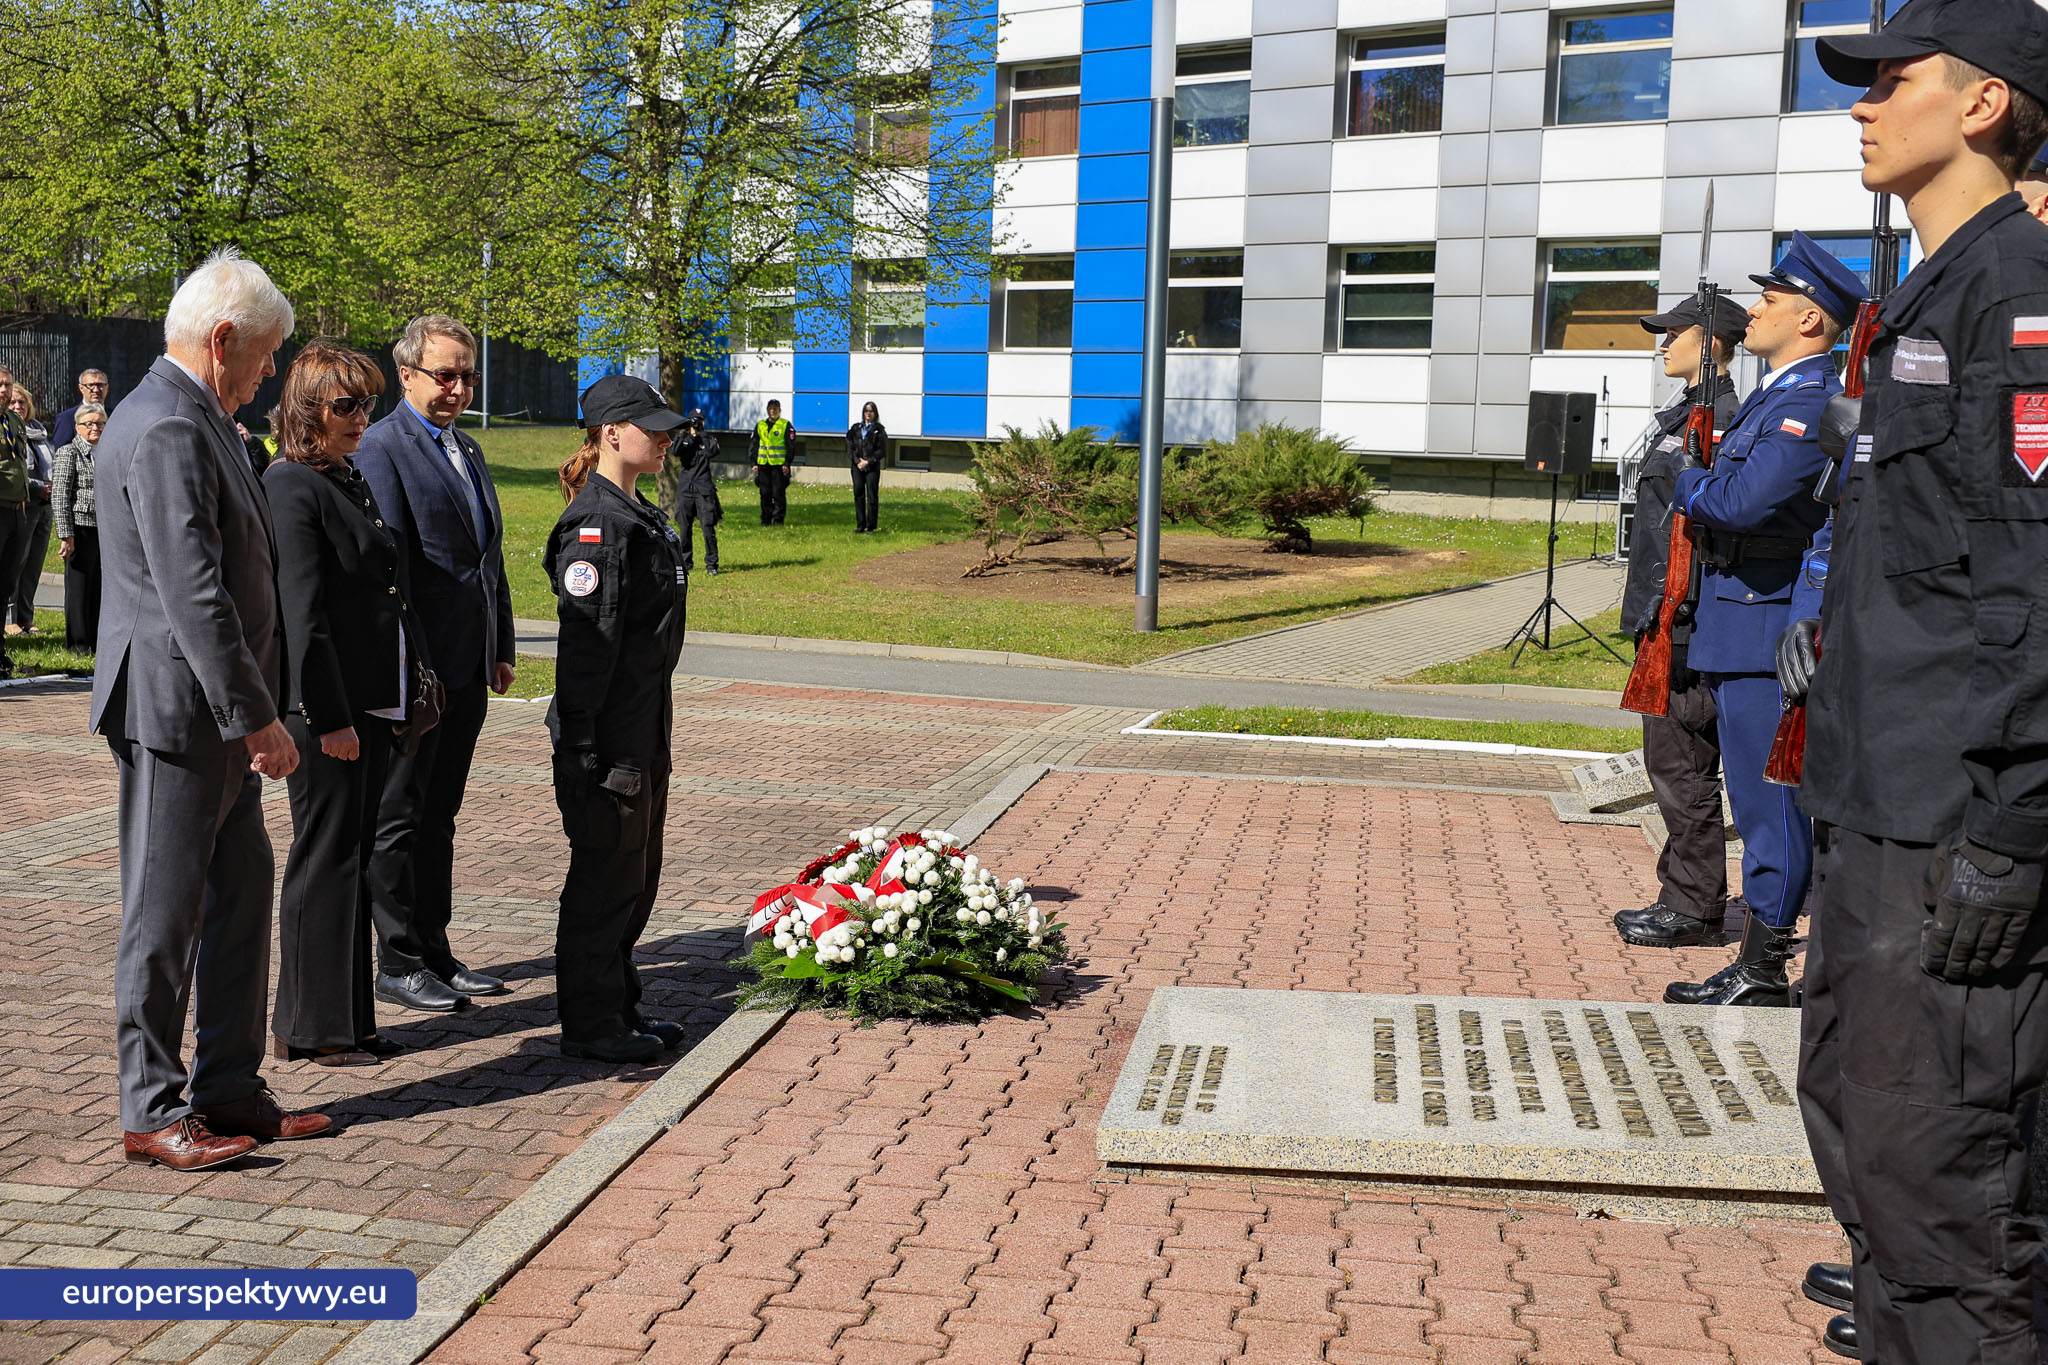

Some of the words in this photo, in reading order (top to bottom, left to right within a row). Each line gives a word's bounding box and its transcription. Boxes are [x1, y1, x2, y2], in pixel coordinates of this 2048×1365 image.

[2024, 396, 2046, 407] ZDZ
[1374, 1026, 1396, 1052] WOJNY
[1459, 1010, 1483, 1045] JEDNEGO
[1582, 1008, 1632, 1085] ZAMORDOWANEGO
[1681, 1025, 1726, 1076] POCHOWANO
[1374, 1052, 1401, 1103] ŚWIATOWEJ
[1422, 1080, 1445, 1089] W
[1463, 1049, 1497, 1091] SPOŚRÓD
[1514, 1075, 1538, 1084] W
[1541, 1010, 1563, 1018] W
[1552, 1045, 1600, 1129] EKSHUMOWANEGO
[1625, 1011, 1676, 1068] NIEZNANEGO
[1653, 1071, 1712, 1138] POLICJANTA
[1613, 1087, 1638, 1096] W
[1752, 1070, 1797, 1106] GROBIE
[1423, 1091, 1449, 1126] CZASIE
[1471, 1095, 1497, 1121] 15000
[1617, 1099, 1655, 1138] TWERZE
